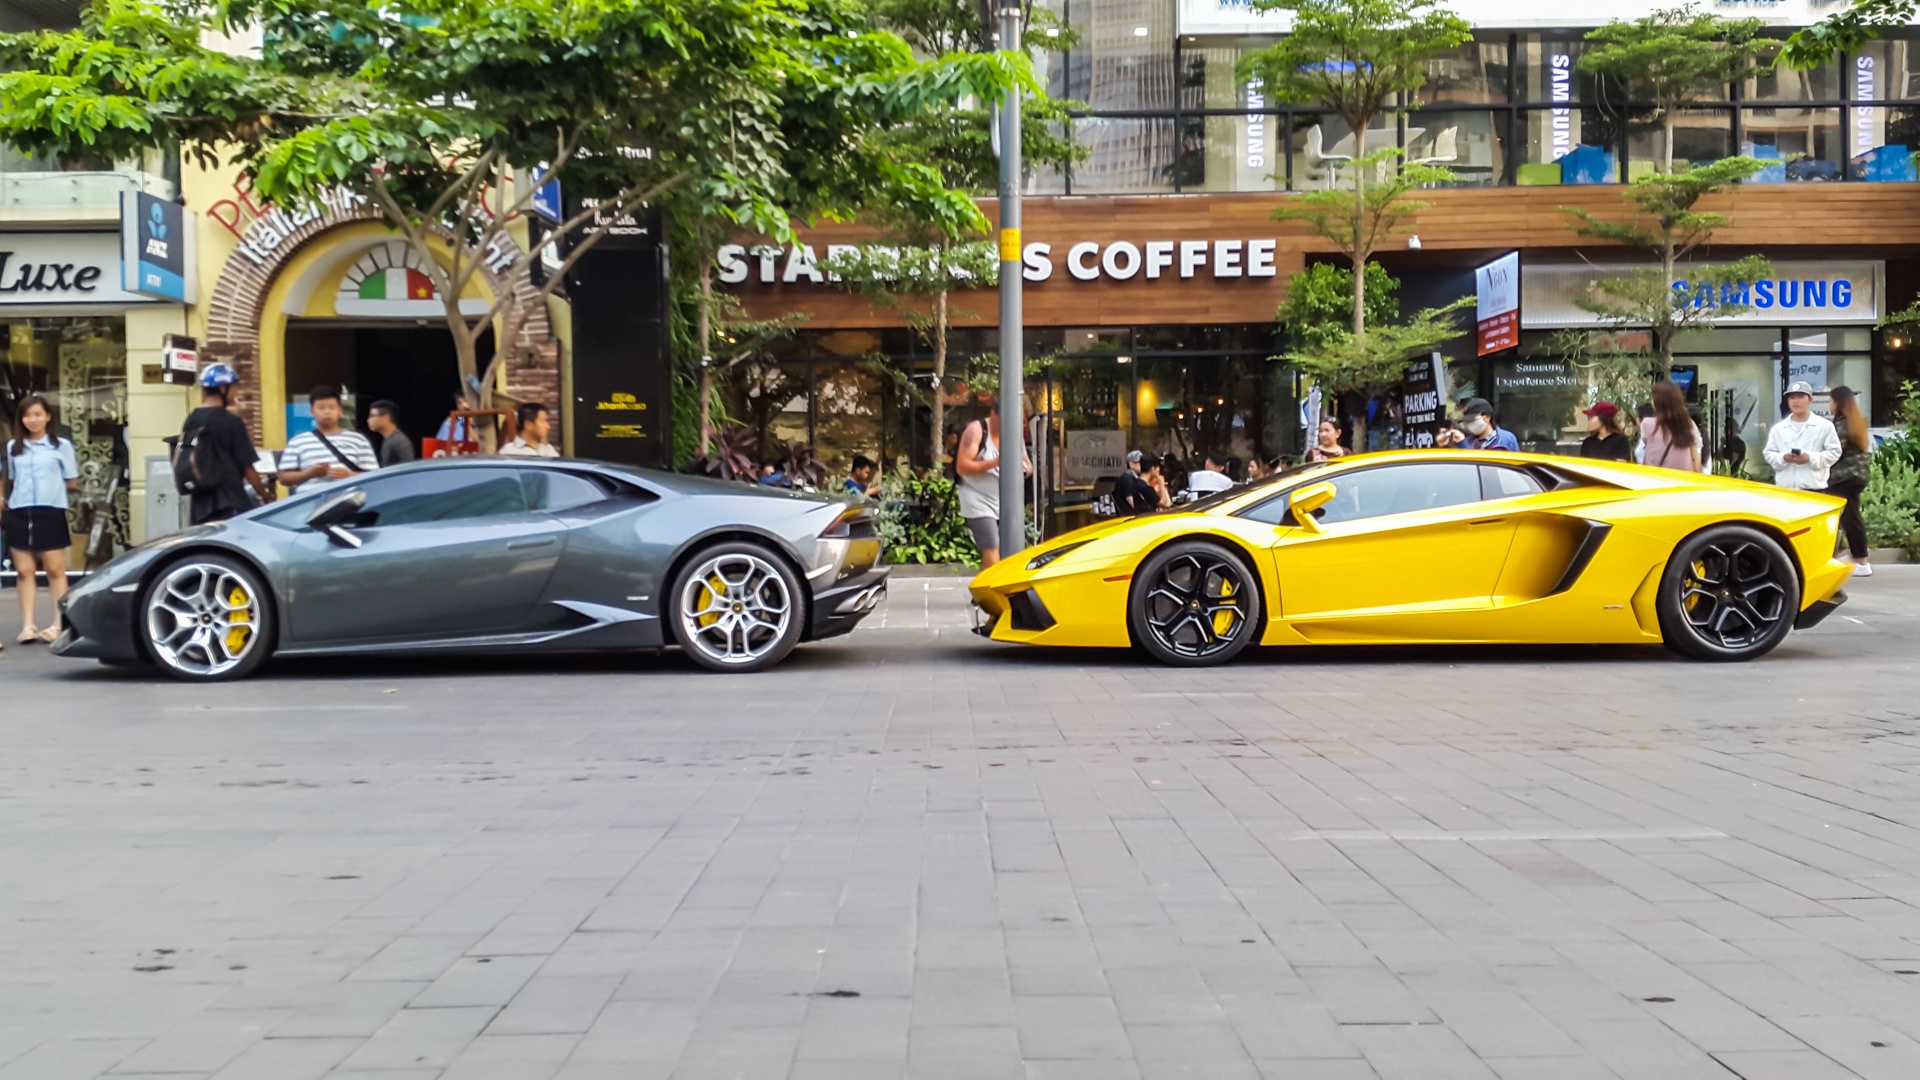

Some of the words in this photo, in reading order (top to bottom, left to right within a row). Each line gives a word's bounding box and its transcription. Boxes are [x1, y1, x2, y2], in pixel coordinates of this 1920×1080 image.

[1247, 65, 1265, 168] AMSUNG
[1857, 56, 1874, 156] SAMSUN
[0, 251, 102, 292] Luxe
[1066, 239, 1277, 281] COFFEE
[1672, 279, 1852, 309] SAMSUNG
[1404, 391, 1437, 414] PARKING
